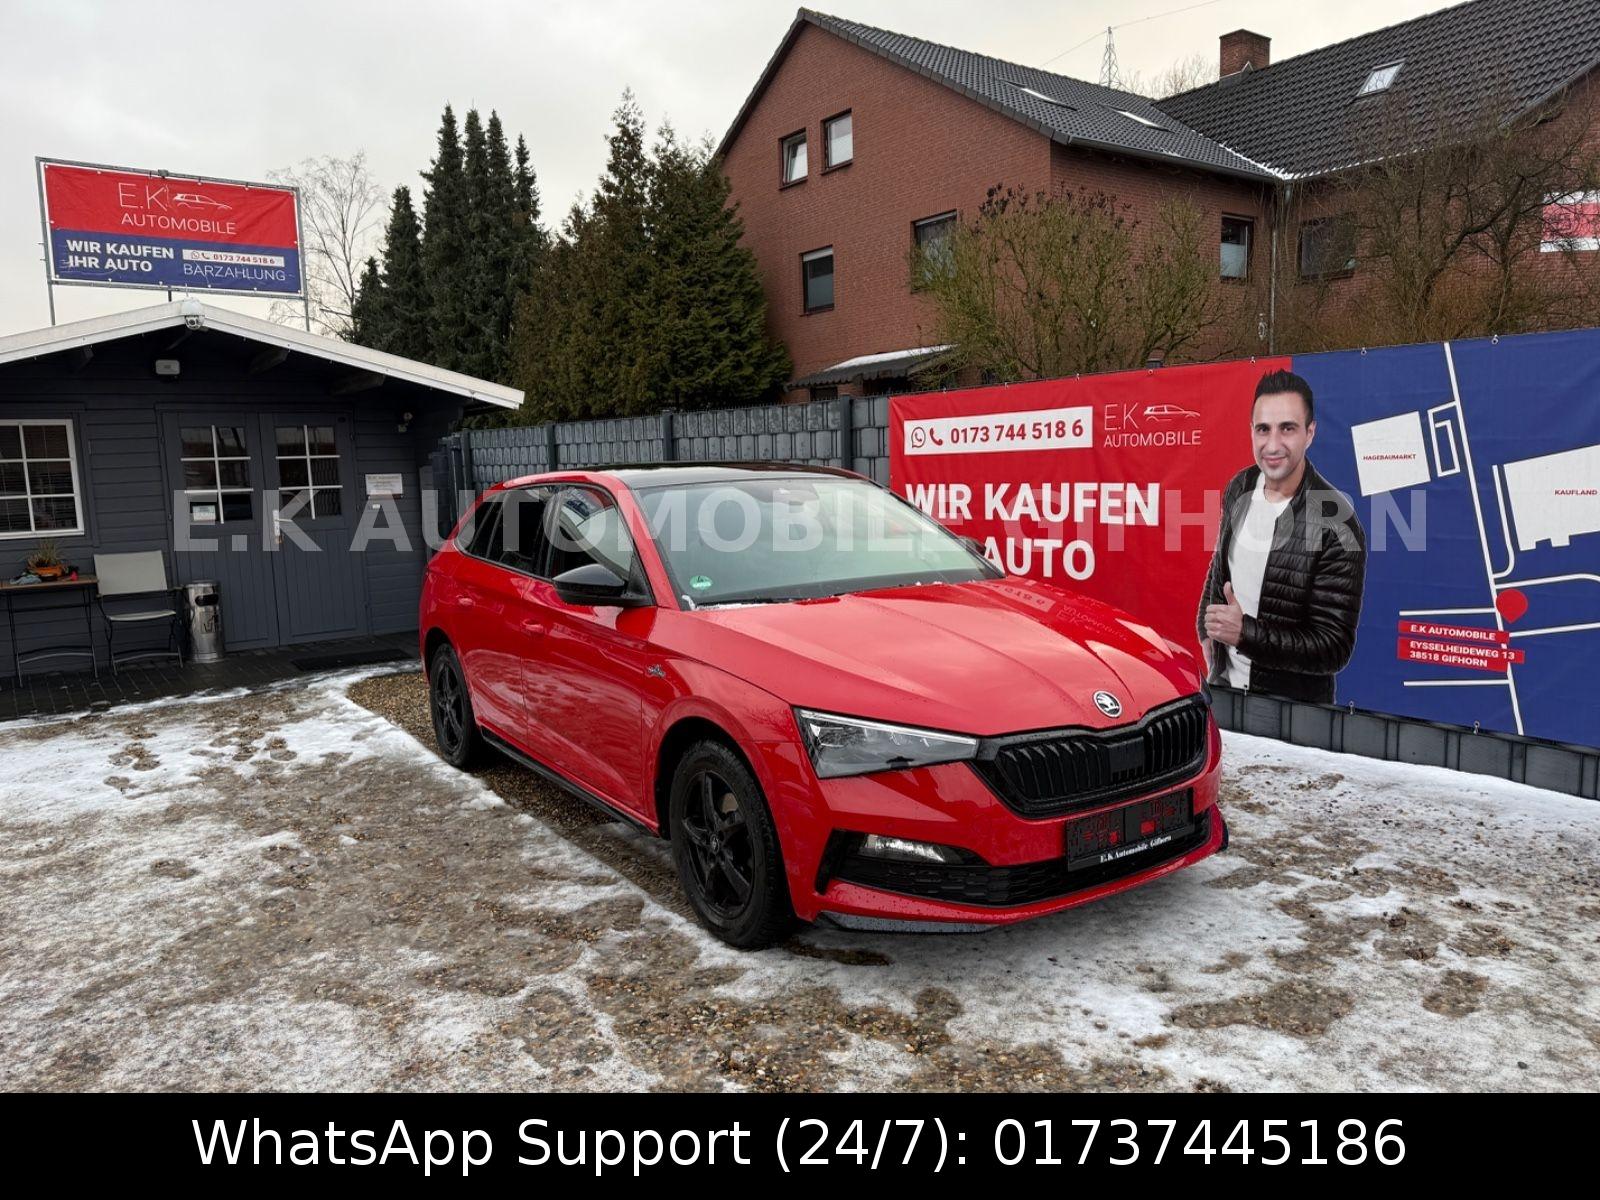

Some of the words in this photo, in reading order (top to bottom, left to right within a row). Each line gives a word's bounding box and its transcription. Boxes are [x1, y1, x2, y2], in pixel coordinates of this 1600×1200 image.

[118, 182, 168, 212] E.K
[121, 212, 237, 235] AUTOMOBILE
[66, 239, 101, 255] WIR
[106, 242, 174, 259] KAUFEN
[213, 253, 235, 262] 0173
[235, 254, 251, 263] 744
[252, 255, 268, 264] 518
[269, 257, 275, 265] 6
[68, 256, 100, 269] IHR
[104, 258, 153, 272] AUTO
[183, 264, 286, 281] BARZAHLUNG
[1103, 402, 1139, 431] E.K
[950, 425, 990, 445] 0173
[994, 423, 1026, 442] 744
[1032, 420, 1066, 440] 518
[1072, 418, 1084, 437] 6
[1103, 430, 1202, 448] AUTOMOBILE
[1363, 453, 1417, 461] HAGEBAUMARKT
[905, 483, 973, 520] WIR
[984, 482, 1161, 527] KAUFEN
[983, 536, 1096, 581] AUTO
[1410, 624, 1426, 633] E.K
[1428, 626, 1496, 640] AUTOMOBILE
[1410, 640, 1499, 658] EYSSELHEIDEWEG
[1502, 651, 1515, 660] 13
[1410, 651, 1439, 660] 38518
[1441, 654, 1488, 667] GIFHORN
